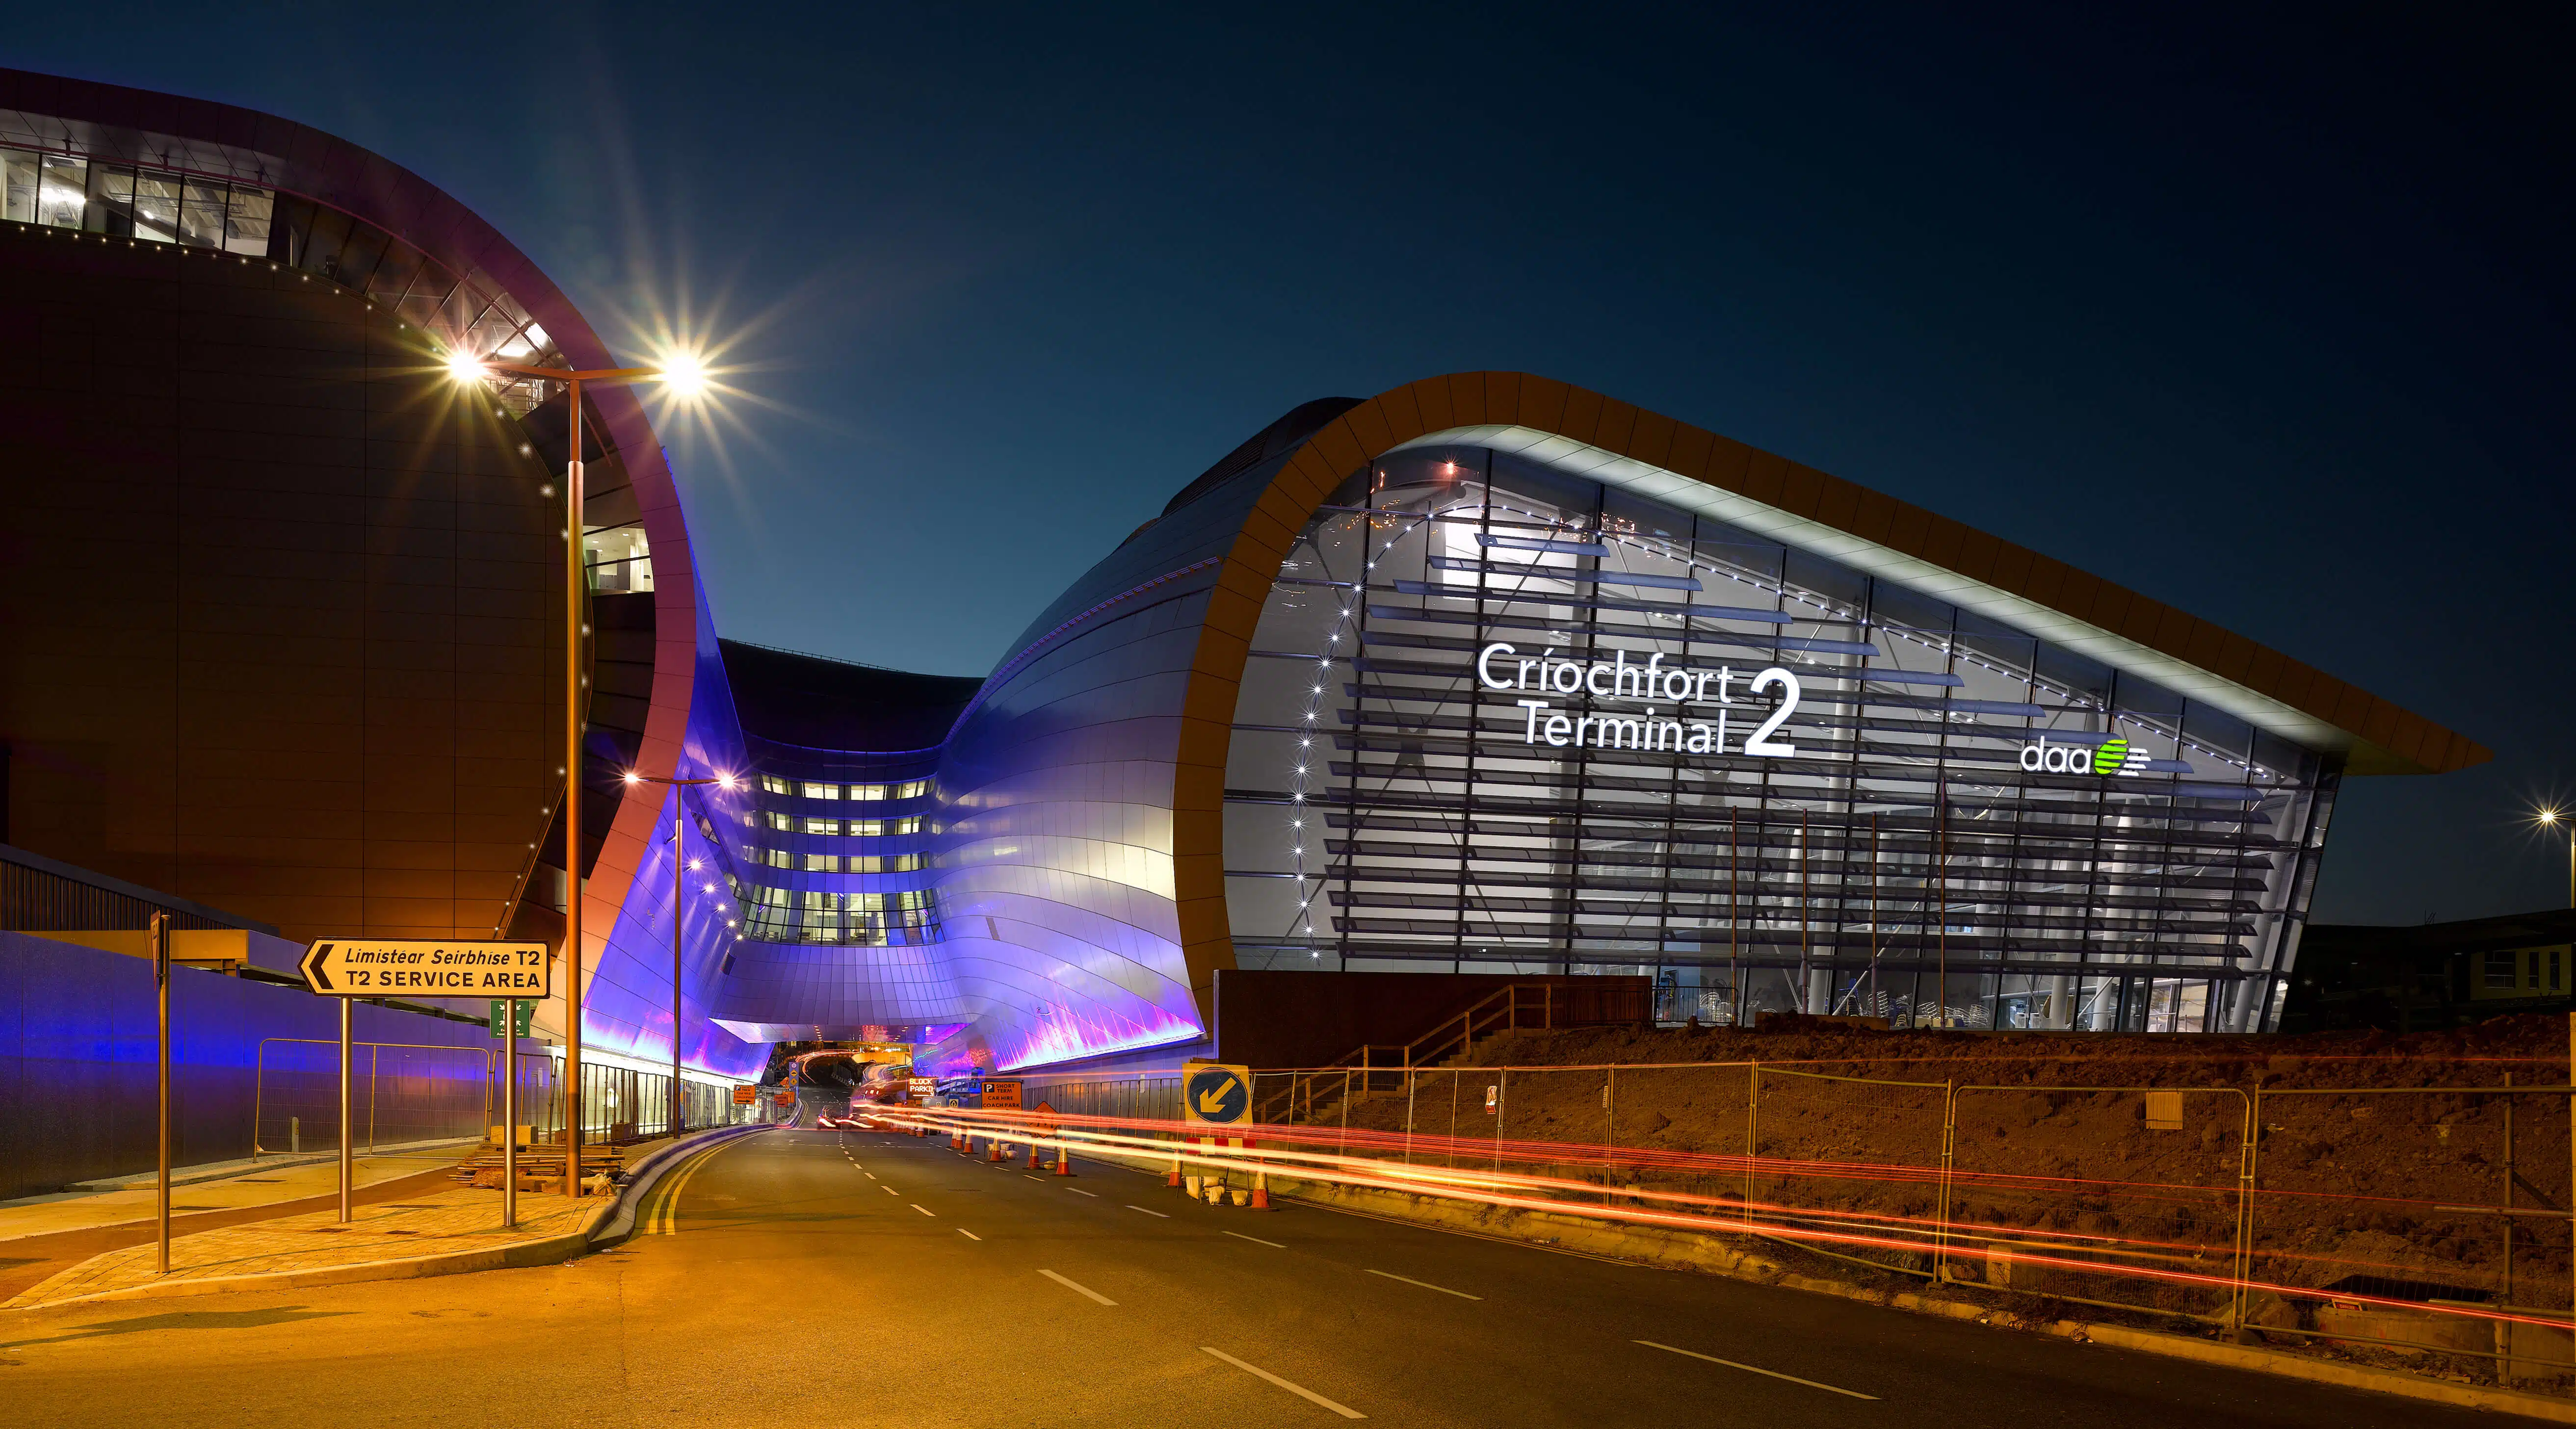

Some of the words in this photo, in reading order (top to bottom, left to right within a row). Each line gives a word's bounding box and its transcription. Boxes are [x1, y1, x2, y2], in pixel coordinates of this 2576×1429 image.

[1477, 643, 1734, 704] Críochfort
[1517, 699, 1727, 754] Terminal
[1744, 667, 1801, 758] 2
[2020, 735, 2092, 774] daa
[345, 948, 425, 964] Limistéar
[431, 949, 510, 965] Seirbhíse
[516, 950, 540, 966] T2
[346, 970, 370, 986] T2
[379, 971, 473, 987] SERVICE
[482, 972, 540, 988] AREA
[986, 1084, 993, 1092] P
